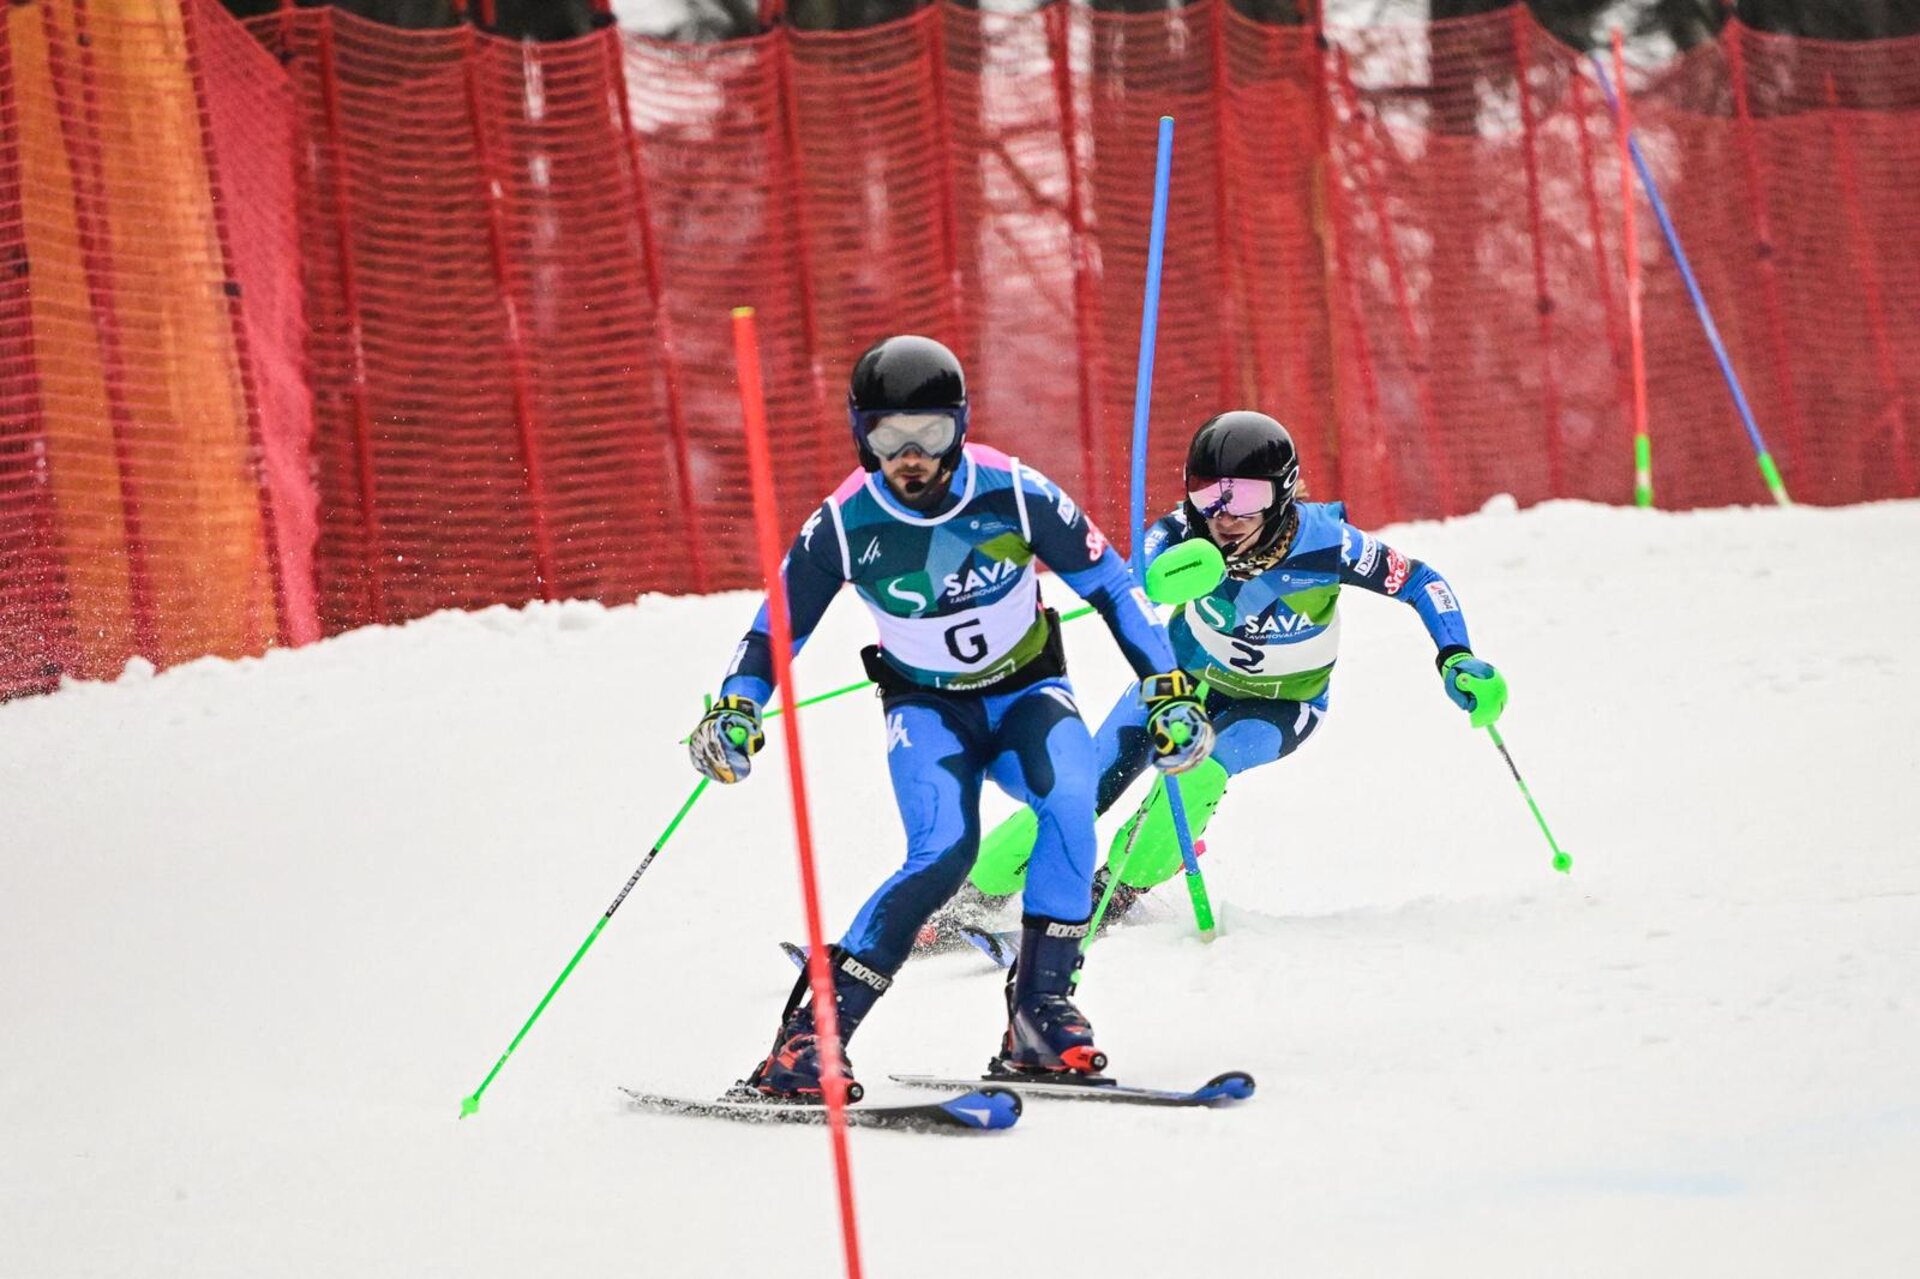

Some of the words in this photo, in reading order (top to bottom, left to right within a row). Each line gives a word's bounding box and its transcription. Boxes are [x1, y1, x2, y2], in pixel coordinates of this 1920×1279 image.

[943, 556, 1018, 597] SAVA
[944, 617, 989, 664] G
[1244, 611, 1315, 634] SAVA
